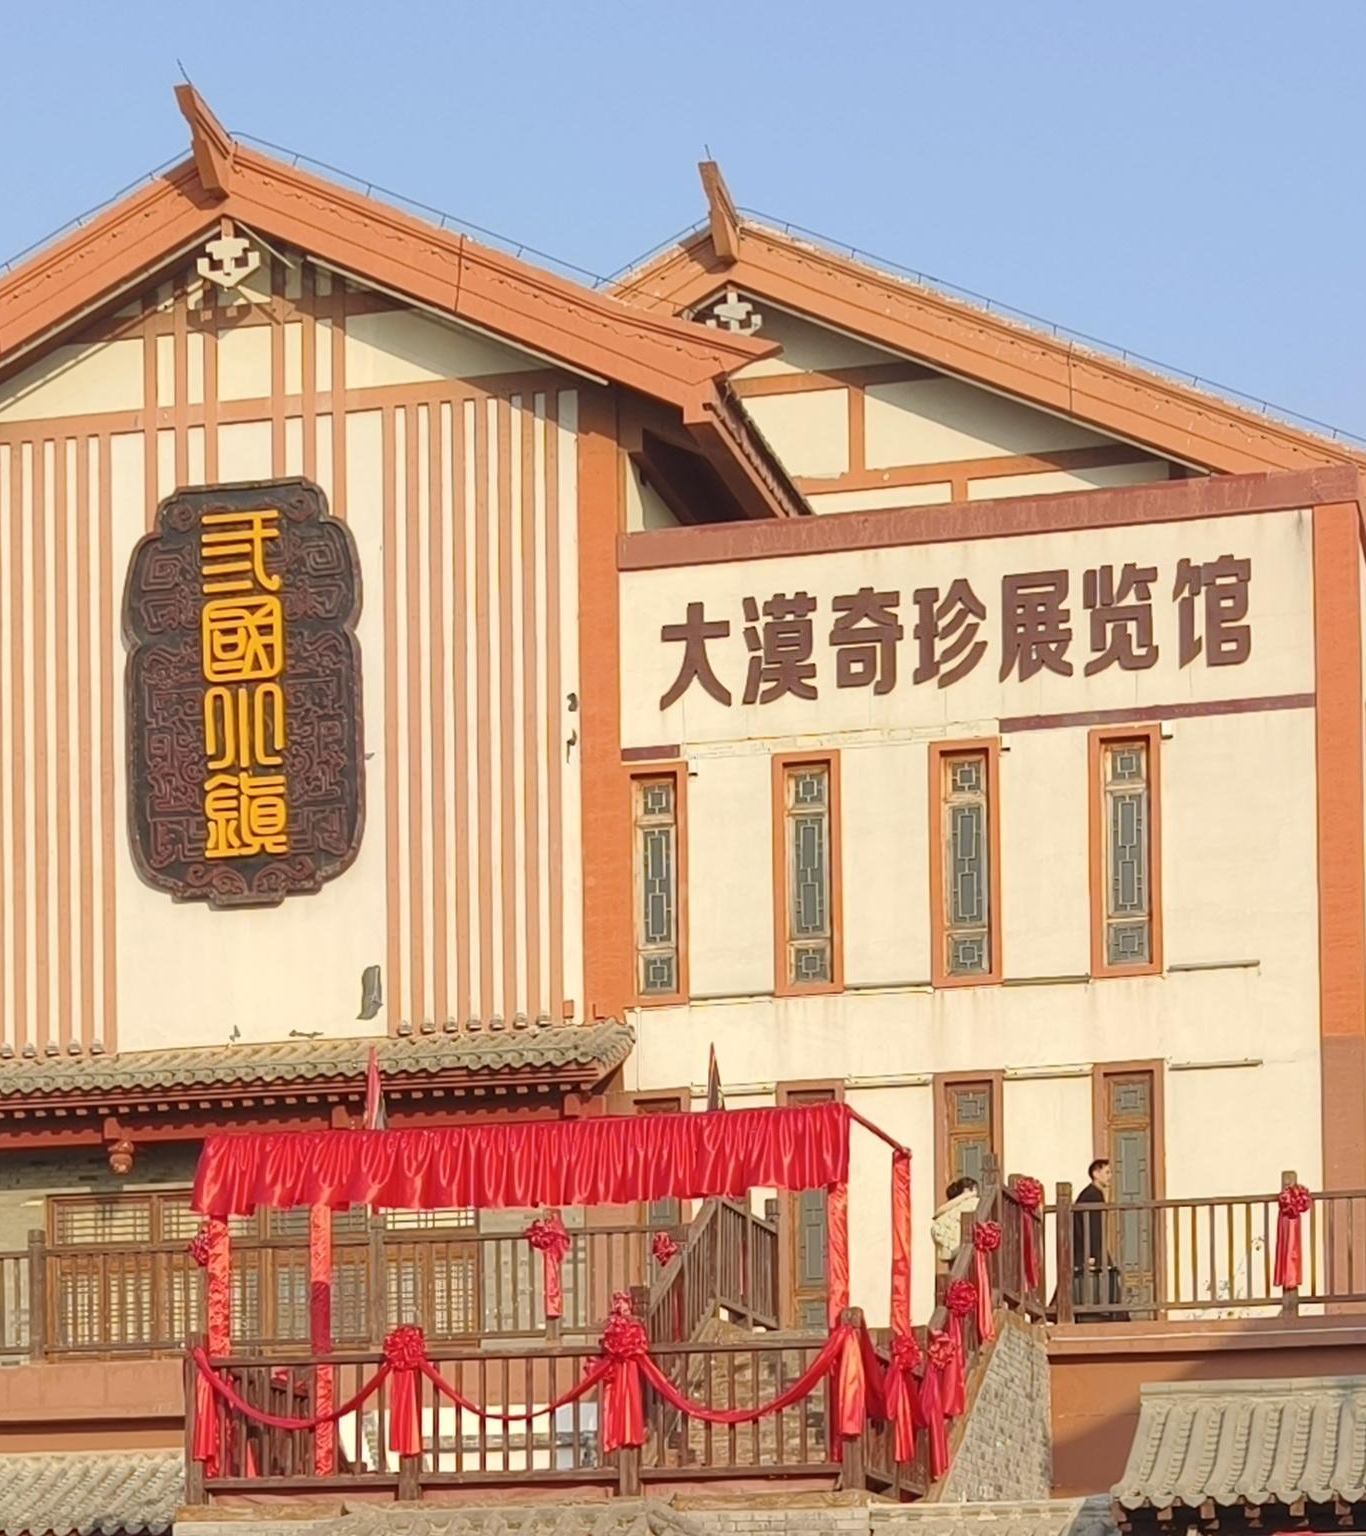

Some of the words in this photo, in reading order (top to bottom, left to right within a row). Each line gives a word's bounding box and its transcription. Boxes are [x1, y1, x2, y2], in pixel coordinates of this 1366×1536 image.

[659, 553, 1253, 711] 大漠奇珍展览馆
